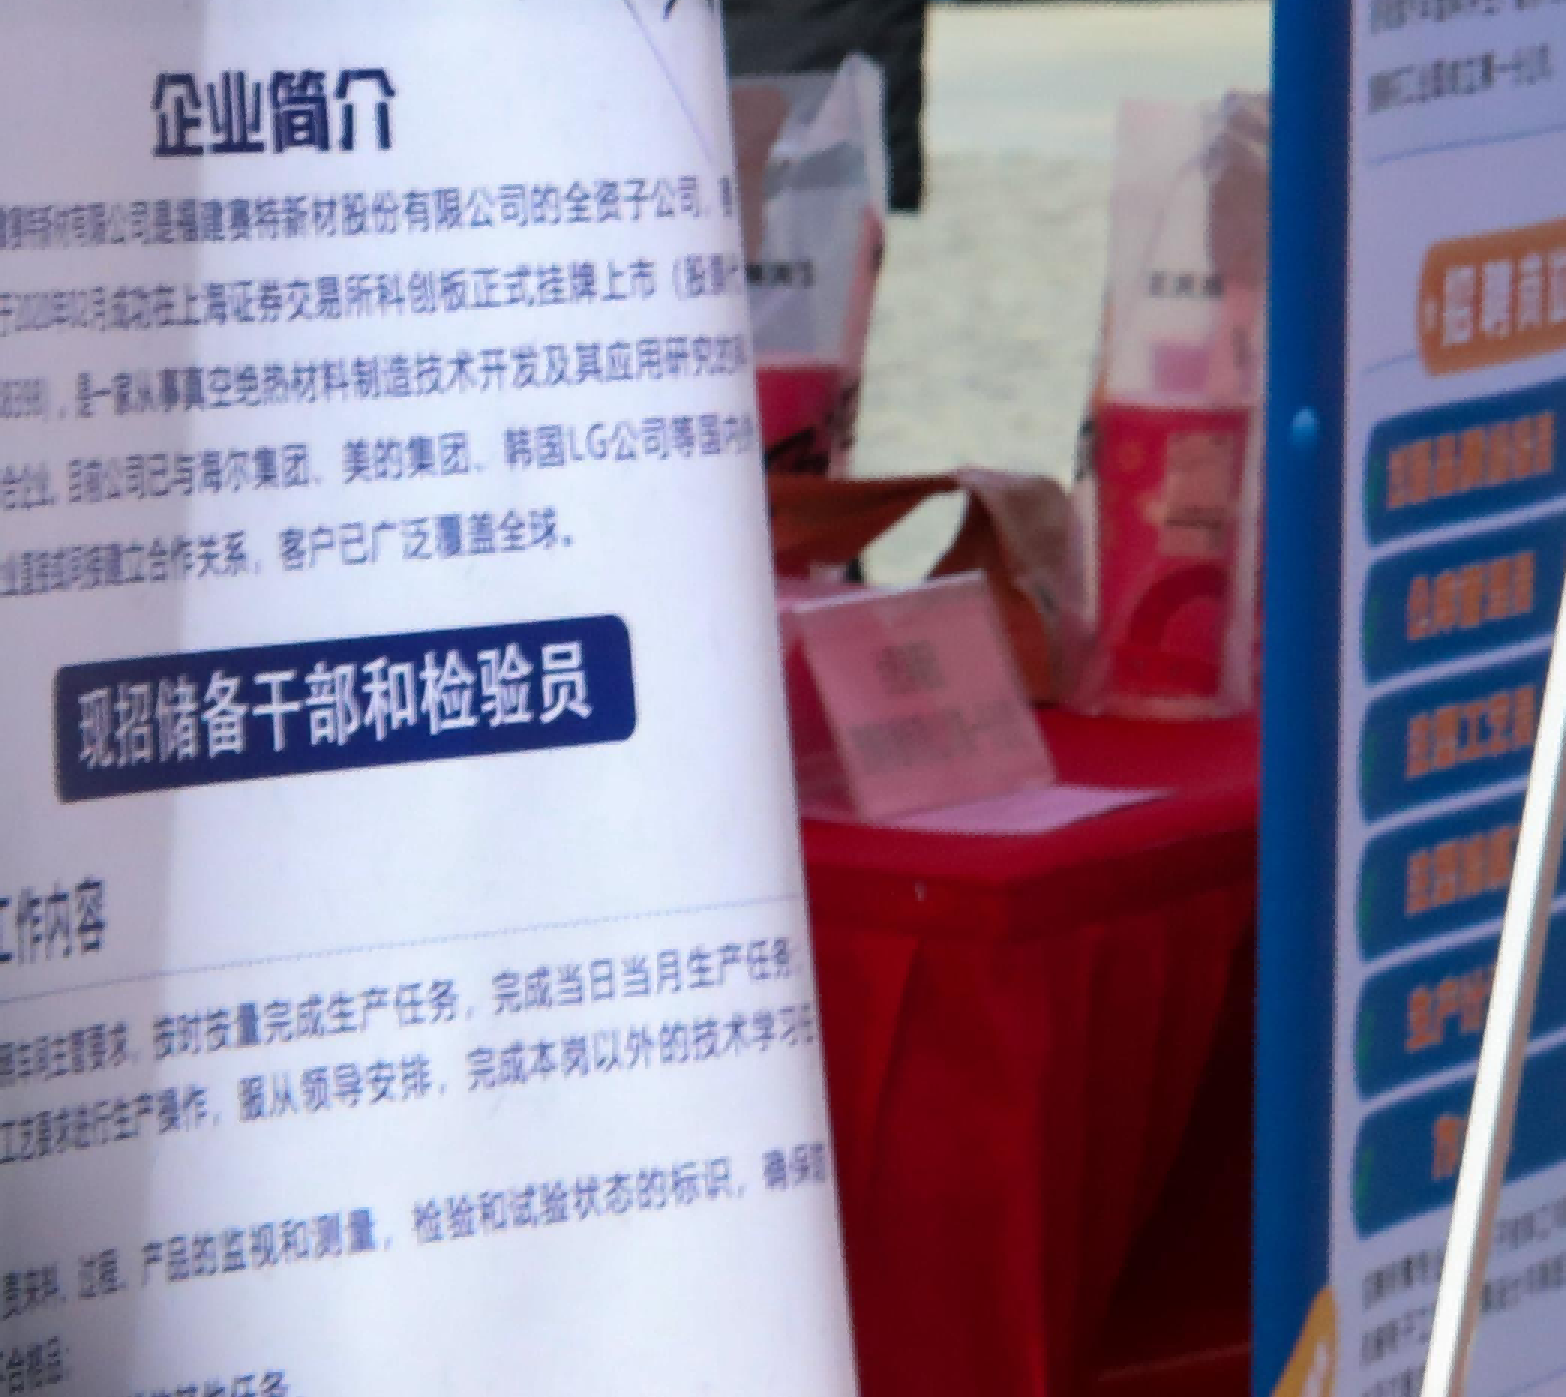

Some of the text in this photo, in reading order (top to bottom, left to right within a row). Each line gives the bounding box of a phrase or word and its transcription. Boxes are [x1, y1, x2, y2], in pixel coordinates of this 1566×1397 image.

[151, 68, 397, 159] 企业简介
[76, 638, 594, 771] 现招储备干部和检验员
